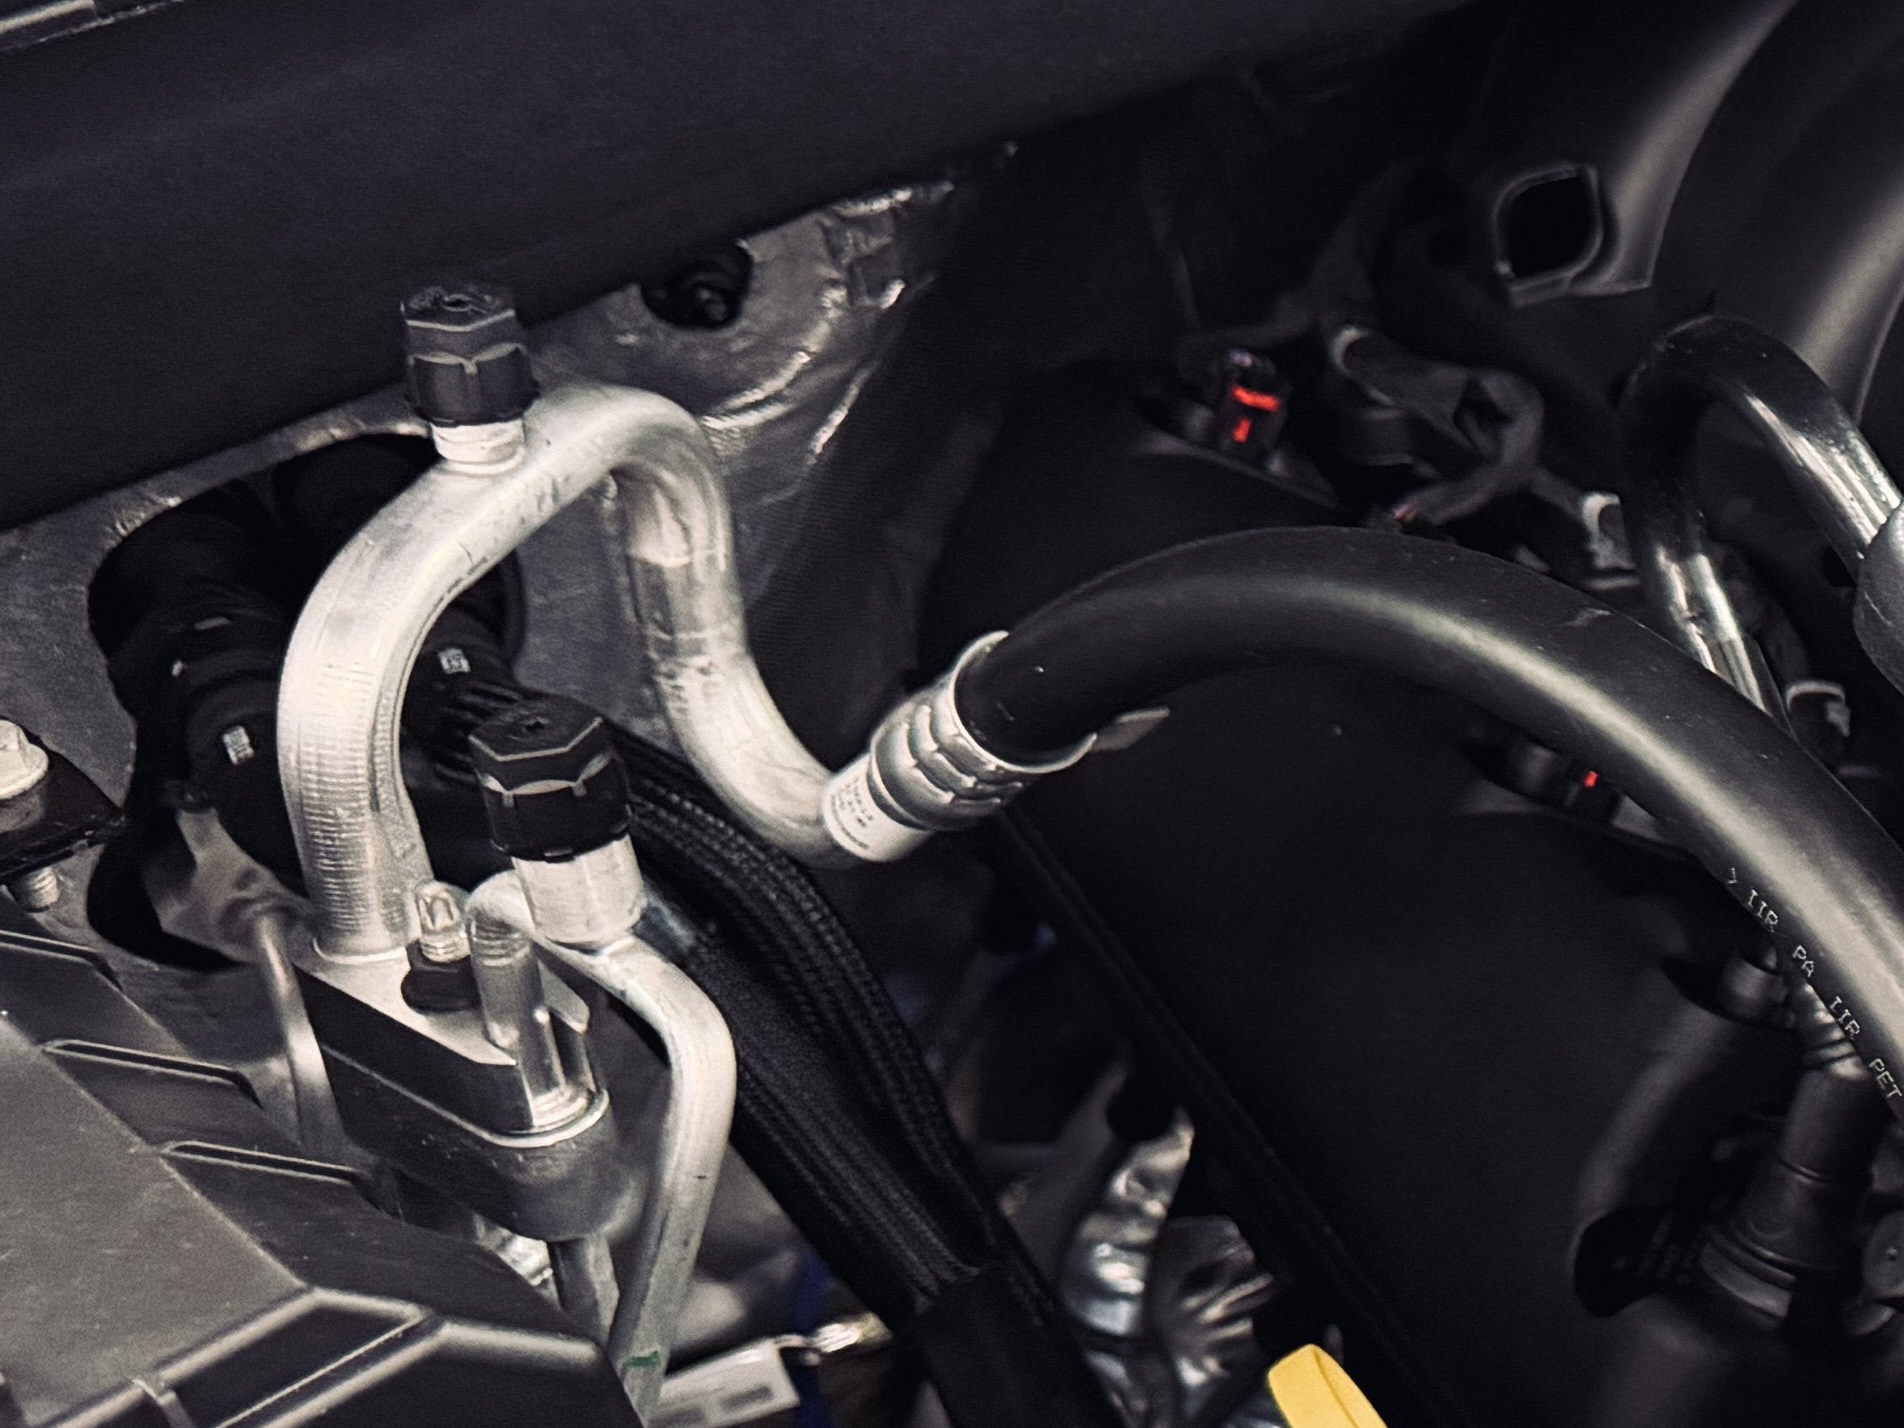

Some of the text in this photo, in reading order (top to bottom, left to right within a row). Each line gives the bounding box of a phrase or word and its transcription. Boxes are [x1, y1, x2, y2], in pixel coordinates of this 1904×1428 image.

[1746, 888, 1780, 933] IIR
[1791, 944, 1815, 978] PA
[1829, 995, 1861, 1039] IIR
[1868, 1057, 1903, 1101] PET
